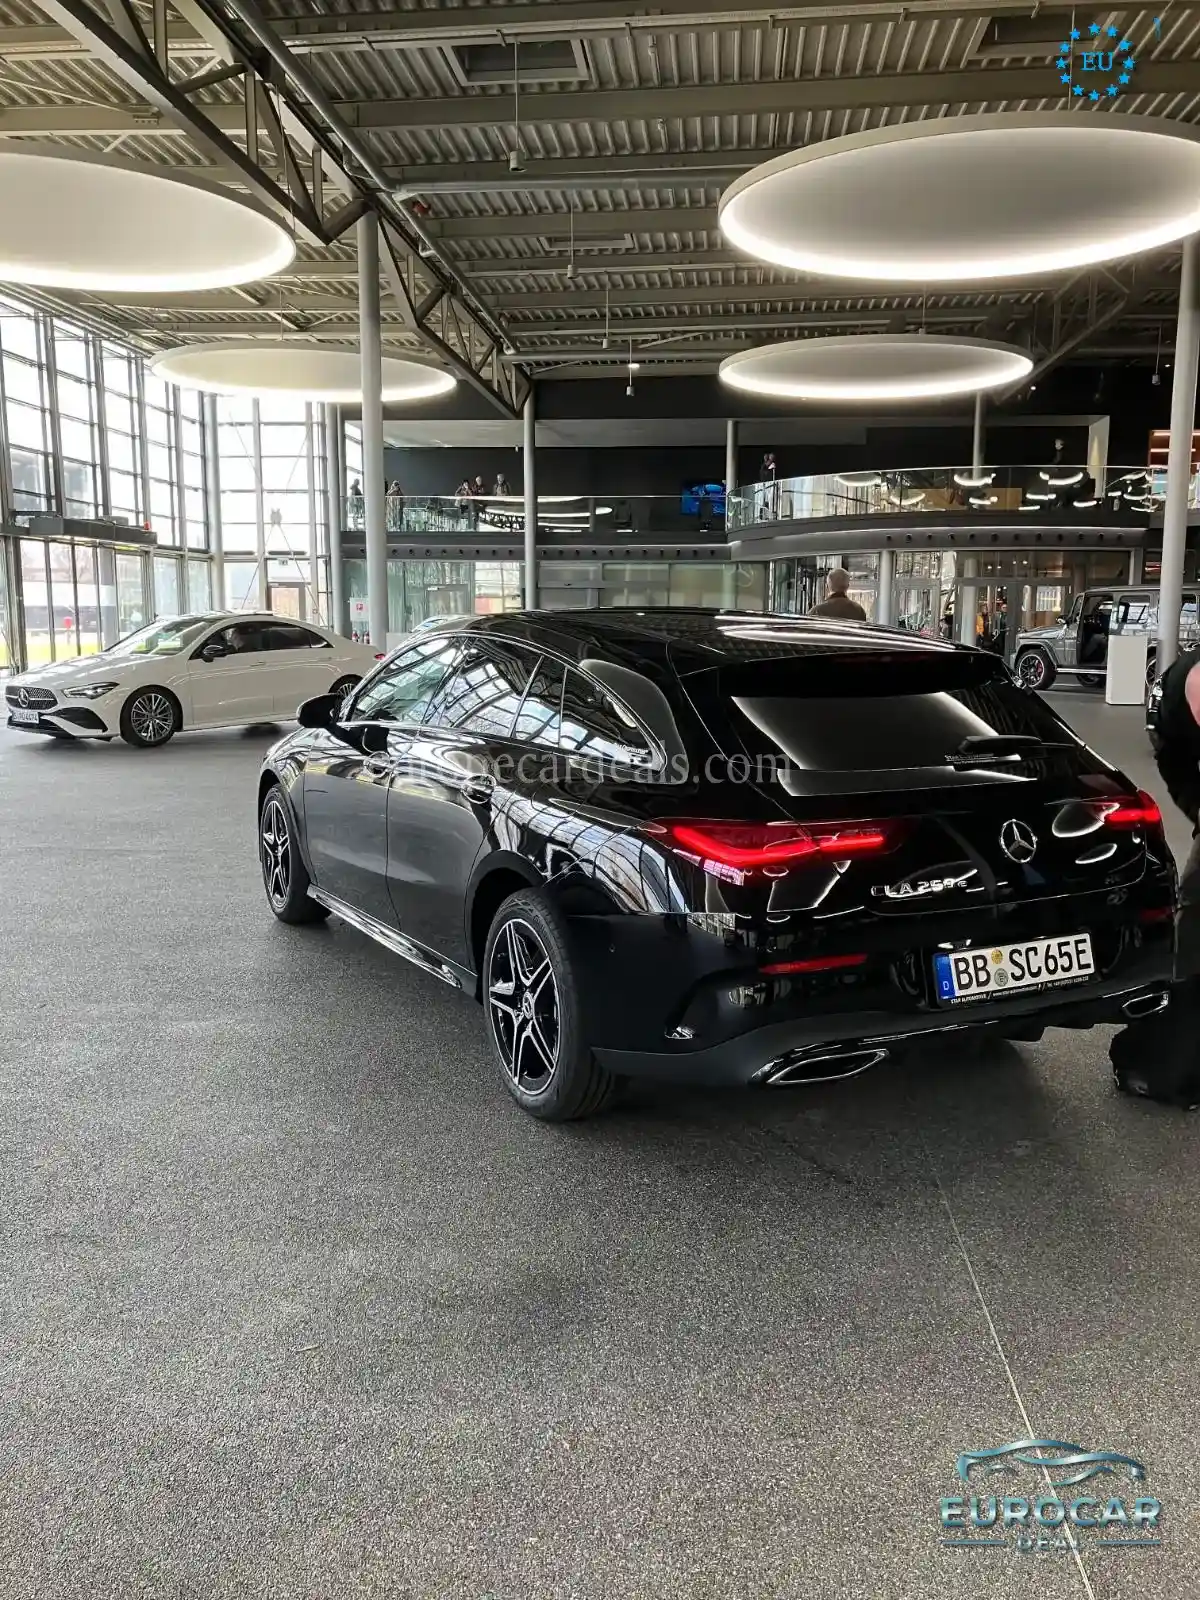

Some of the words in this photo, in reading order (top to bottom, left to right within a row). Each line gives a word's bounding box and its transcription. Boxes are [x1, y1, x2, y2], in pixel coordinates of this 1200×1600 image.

[871, 882, 913, 897] CLA
[953, 954, 991, 991] BB
[1008, 938, 1092, 982] SC65E
[942, 980, 949, 990] D
